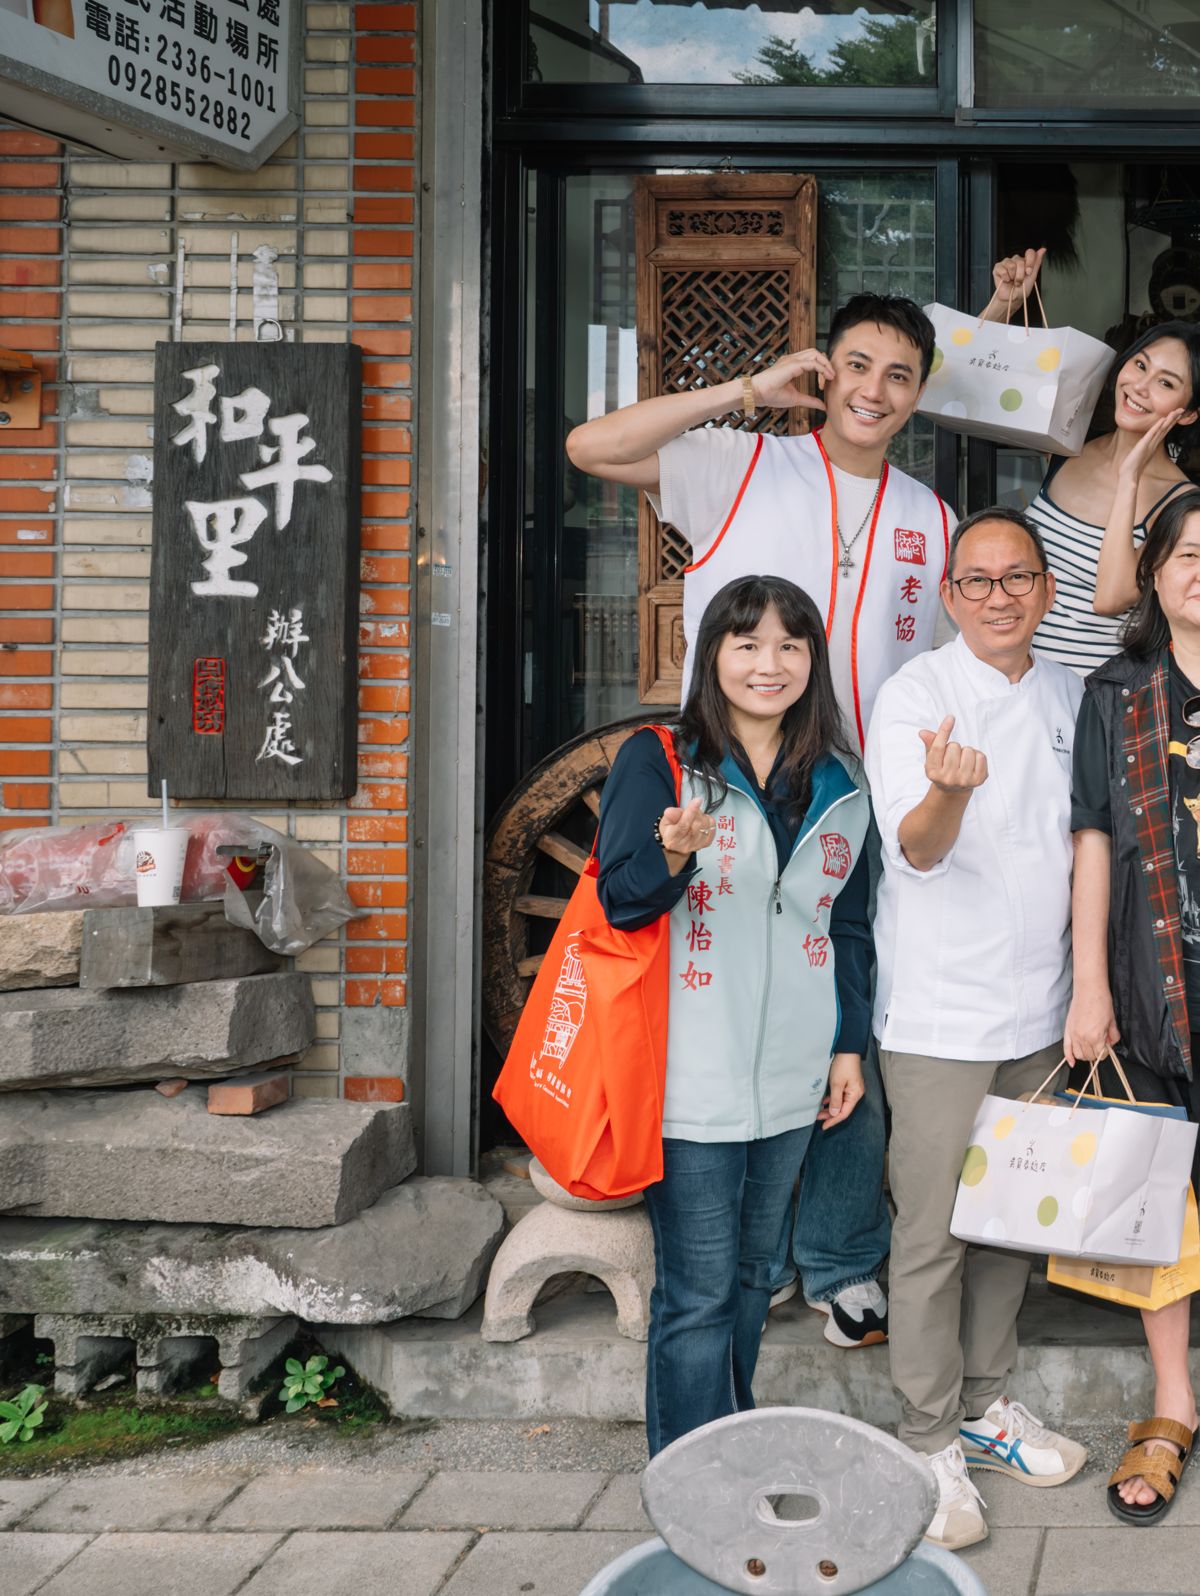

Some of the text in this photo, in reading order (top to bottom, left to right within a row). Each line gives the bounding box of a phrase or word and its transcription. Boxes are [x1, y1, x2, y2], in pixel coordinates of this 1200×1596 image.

[108, 55, 250, 140] 0928552882
[169, 364, 334, 598] 和平里
[895, 575, 922, 642] 老協
[256, 608, 311, 766] 辦公處
[679, 880, 716, 991] 陳怡如
